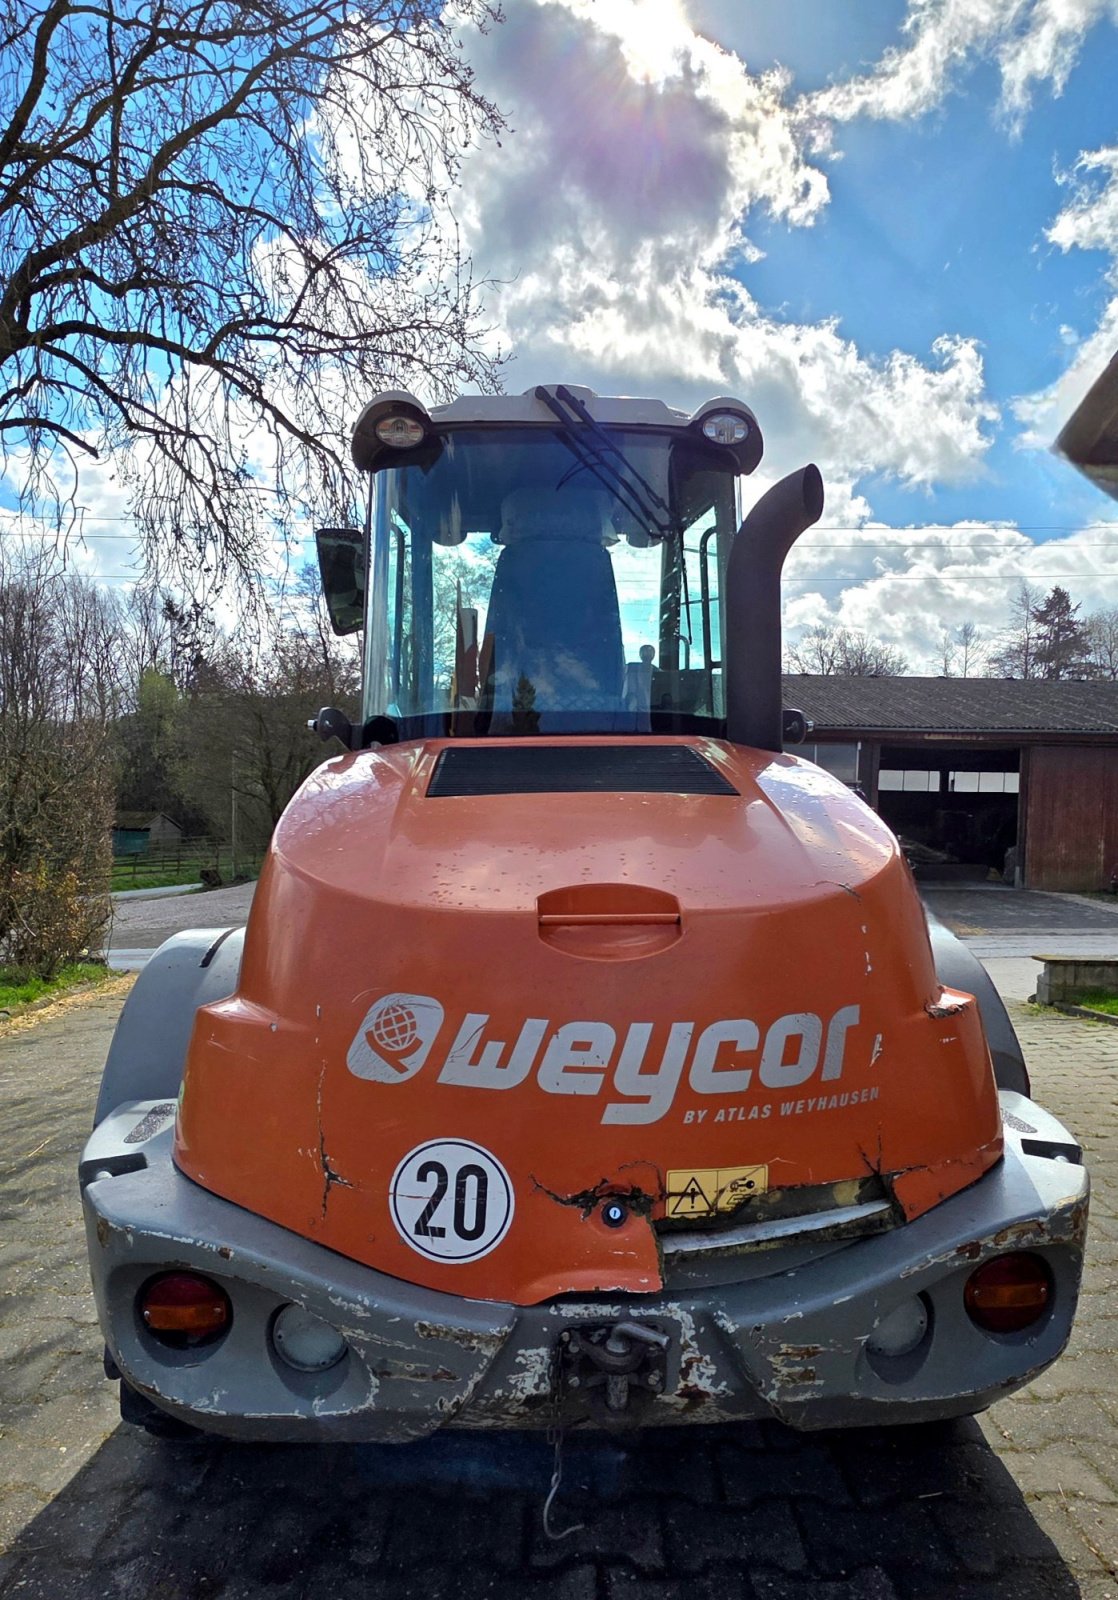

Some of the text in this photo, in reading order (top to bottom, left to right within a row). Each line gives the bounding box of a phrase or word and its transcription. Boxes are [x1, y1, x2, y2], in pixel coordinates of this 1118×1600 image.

[437, 1005, 860, 1124] weycor
[683, 1087, 880, 1124] BY ATLAS WEYHAUSEN
[414, 1161, 488, 1241] 20
